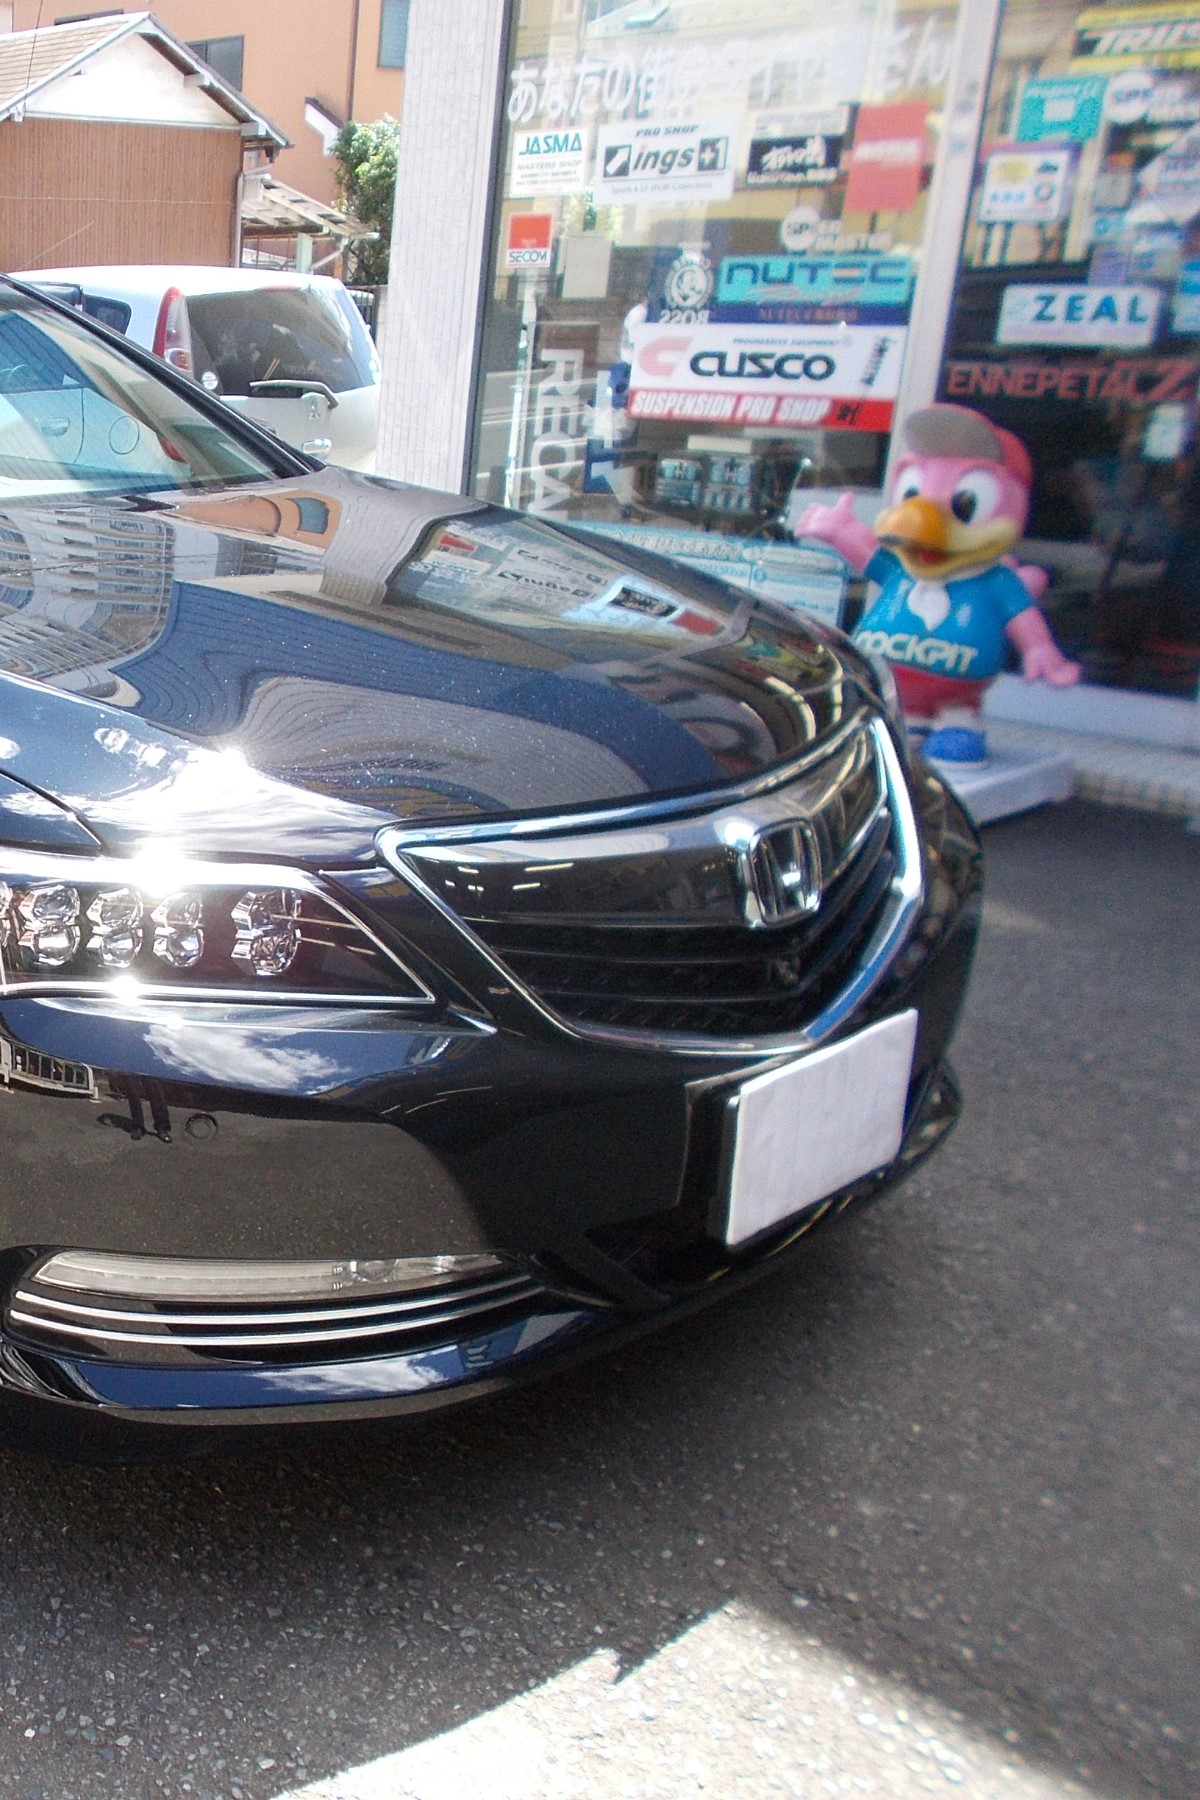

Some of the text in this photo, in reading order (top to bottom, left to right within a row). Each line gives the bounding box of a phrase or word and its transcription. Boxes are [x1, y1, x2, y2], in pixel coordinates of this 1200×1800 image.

[518, 132, 583, 156] JASMA
[663, 124, 700, 136] SHOP
[509, 250, 548, 263] SECOM
[725, 261, 908, 285] NUTEC
[1032, 294, 1149, 323] ZEAL
[689, 350, 836, 381] CUSCO
[634, 390, 736, 420] SUSPENSION
[737, 396, 775, 421] PRO
[778, 397, 831, 423] SHOP
[527, 348, 585, 520] RECA
[855, 629, 980, 674] COCKPIT
